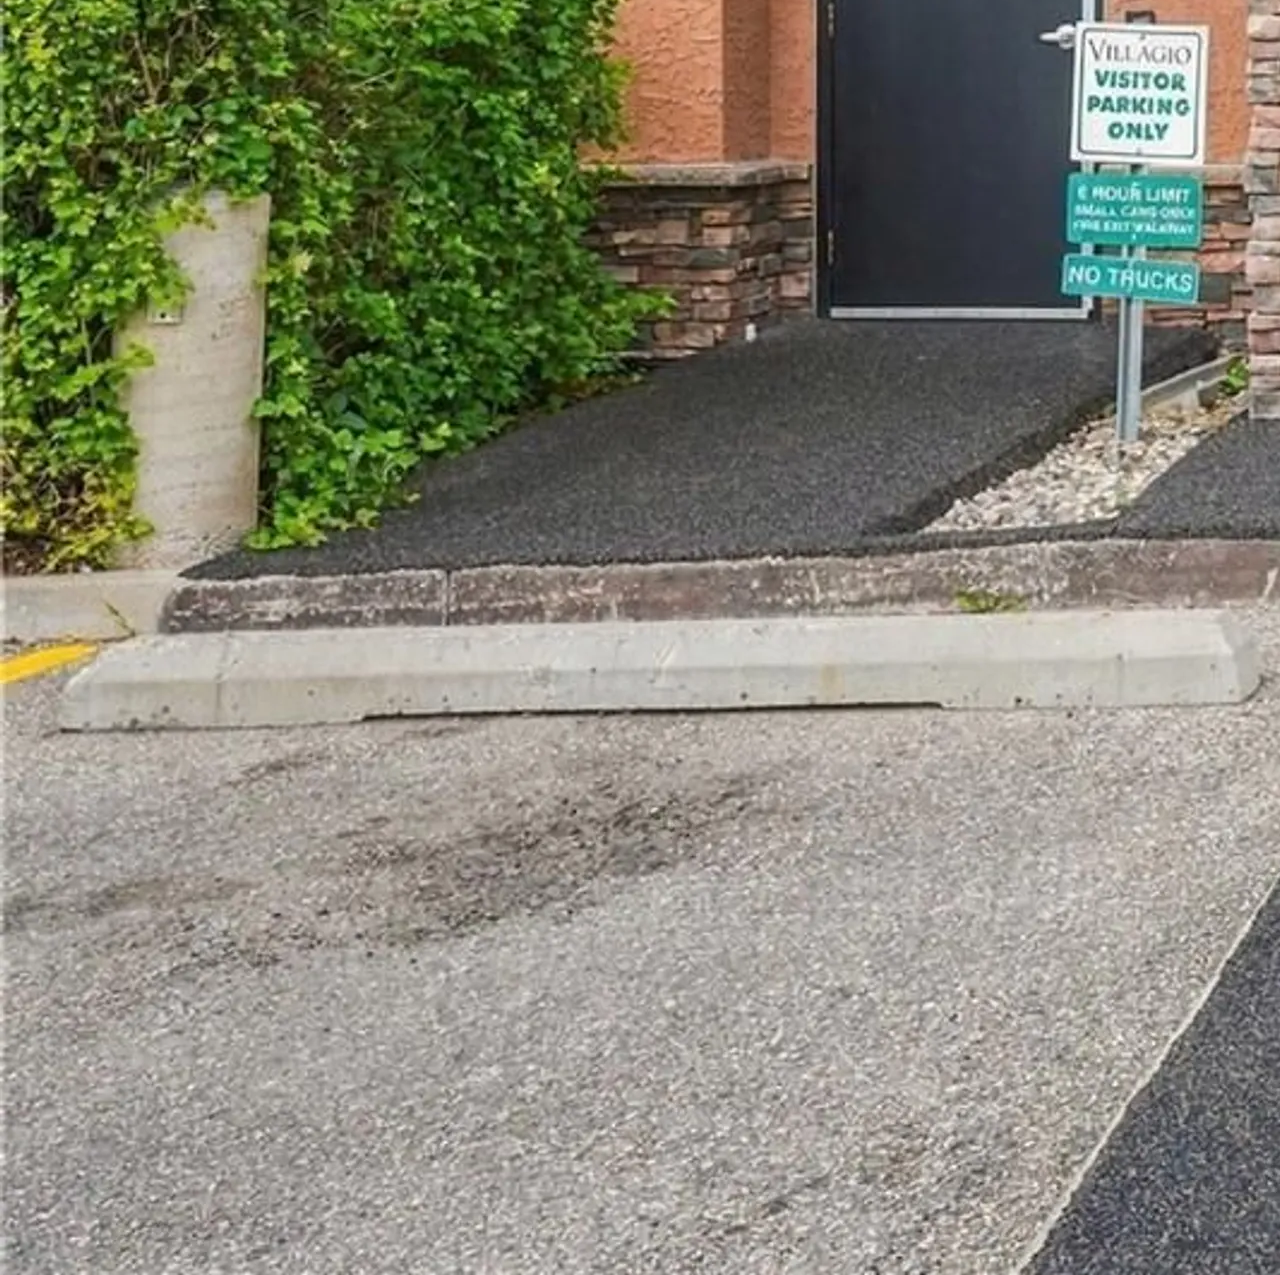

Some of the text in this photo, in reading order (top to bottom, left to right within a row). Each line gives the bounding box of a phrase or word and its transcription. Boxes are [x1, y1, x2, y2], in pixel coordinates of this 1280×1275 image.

[1088, 38, 1192, 66] VILLAGIO
[1094, 69, 1186, 92] VISITOR
[1087, 94, 1191, 117] PARKING
[1107, 122, 1169, 142] ONLY
[1091, 184, 1142, 202] HOUR
[1145, 186, 1191, 204] LIMIT
[1068, 265, 1194, 293] NO TRUCKS
